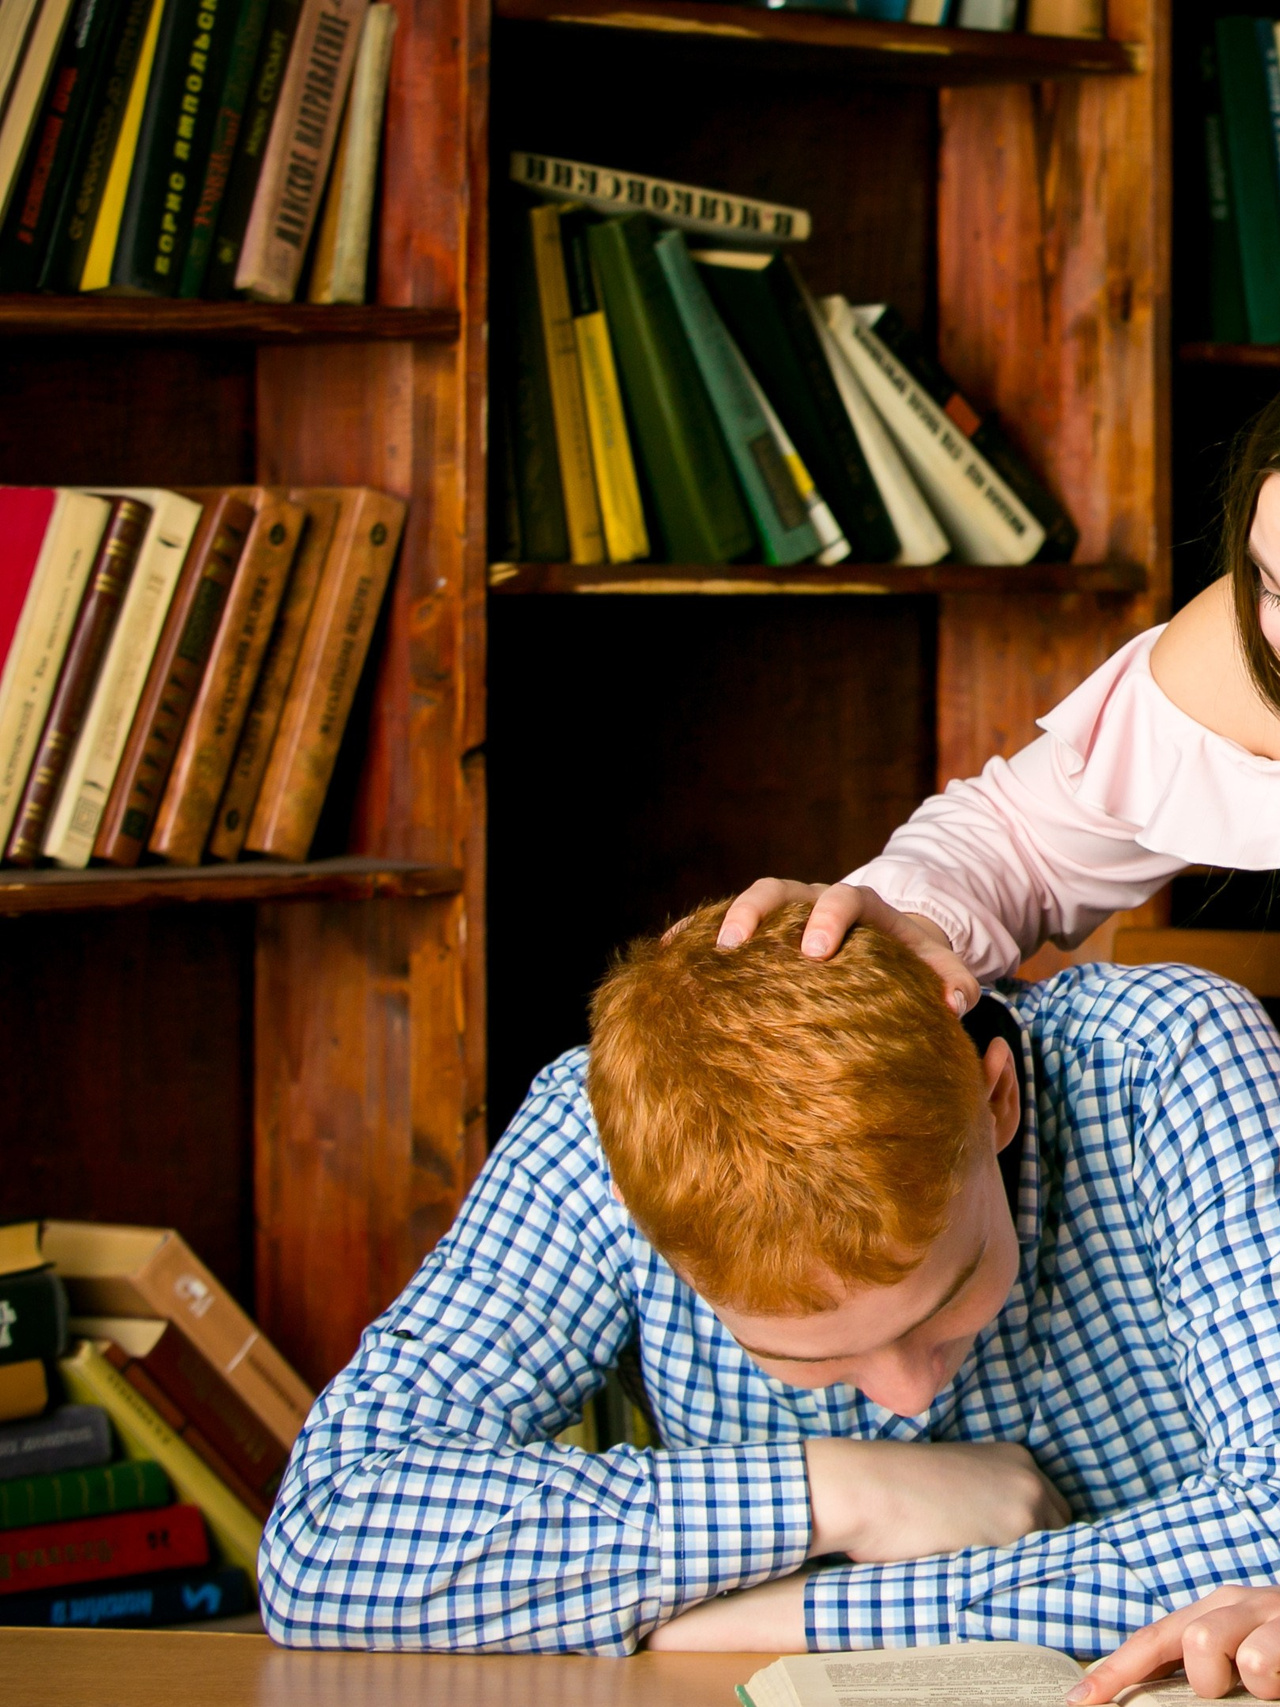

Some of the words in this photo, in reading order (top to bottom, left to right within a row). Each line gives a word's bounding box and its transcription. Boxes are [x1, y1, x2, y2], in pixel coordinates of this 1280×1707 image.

[294, 11, 350, 149] НАПРАВЛЕНИЕ
[154, 171, 186, 275] БОРИС
[275, 150, 318, 249] МИНСКОЕ
